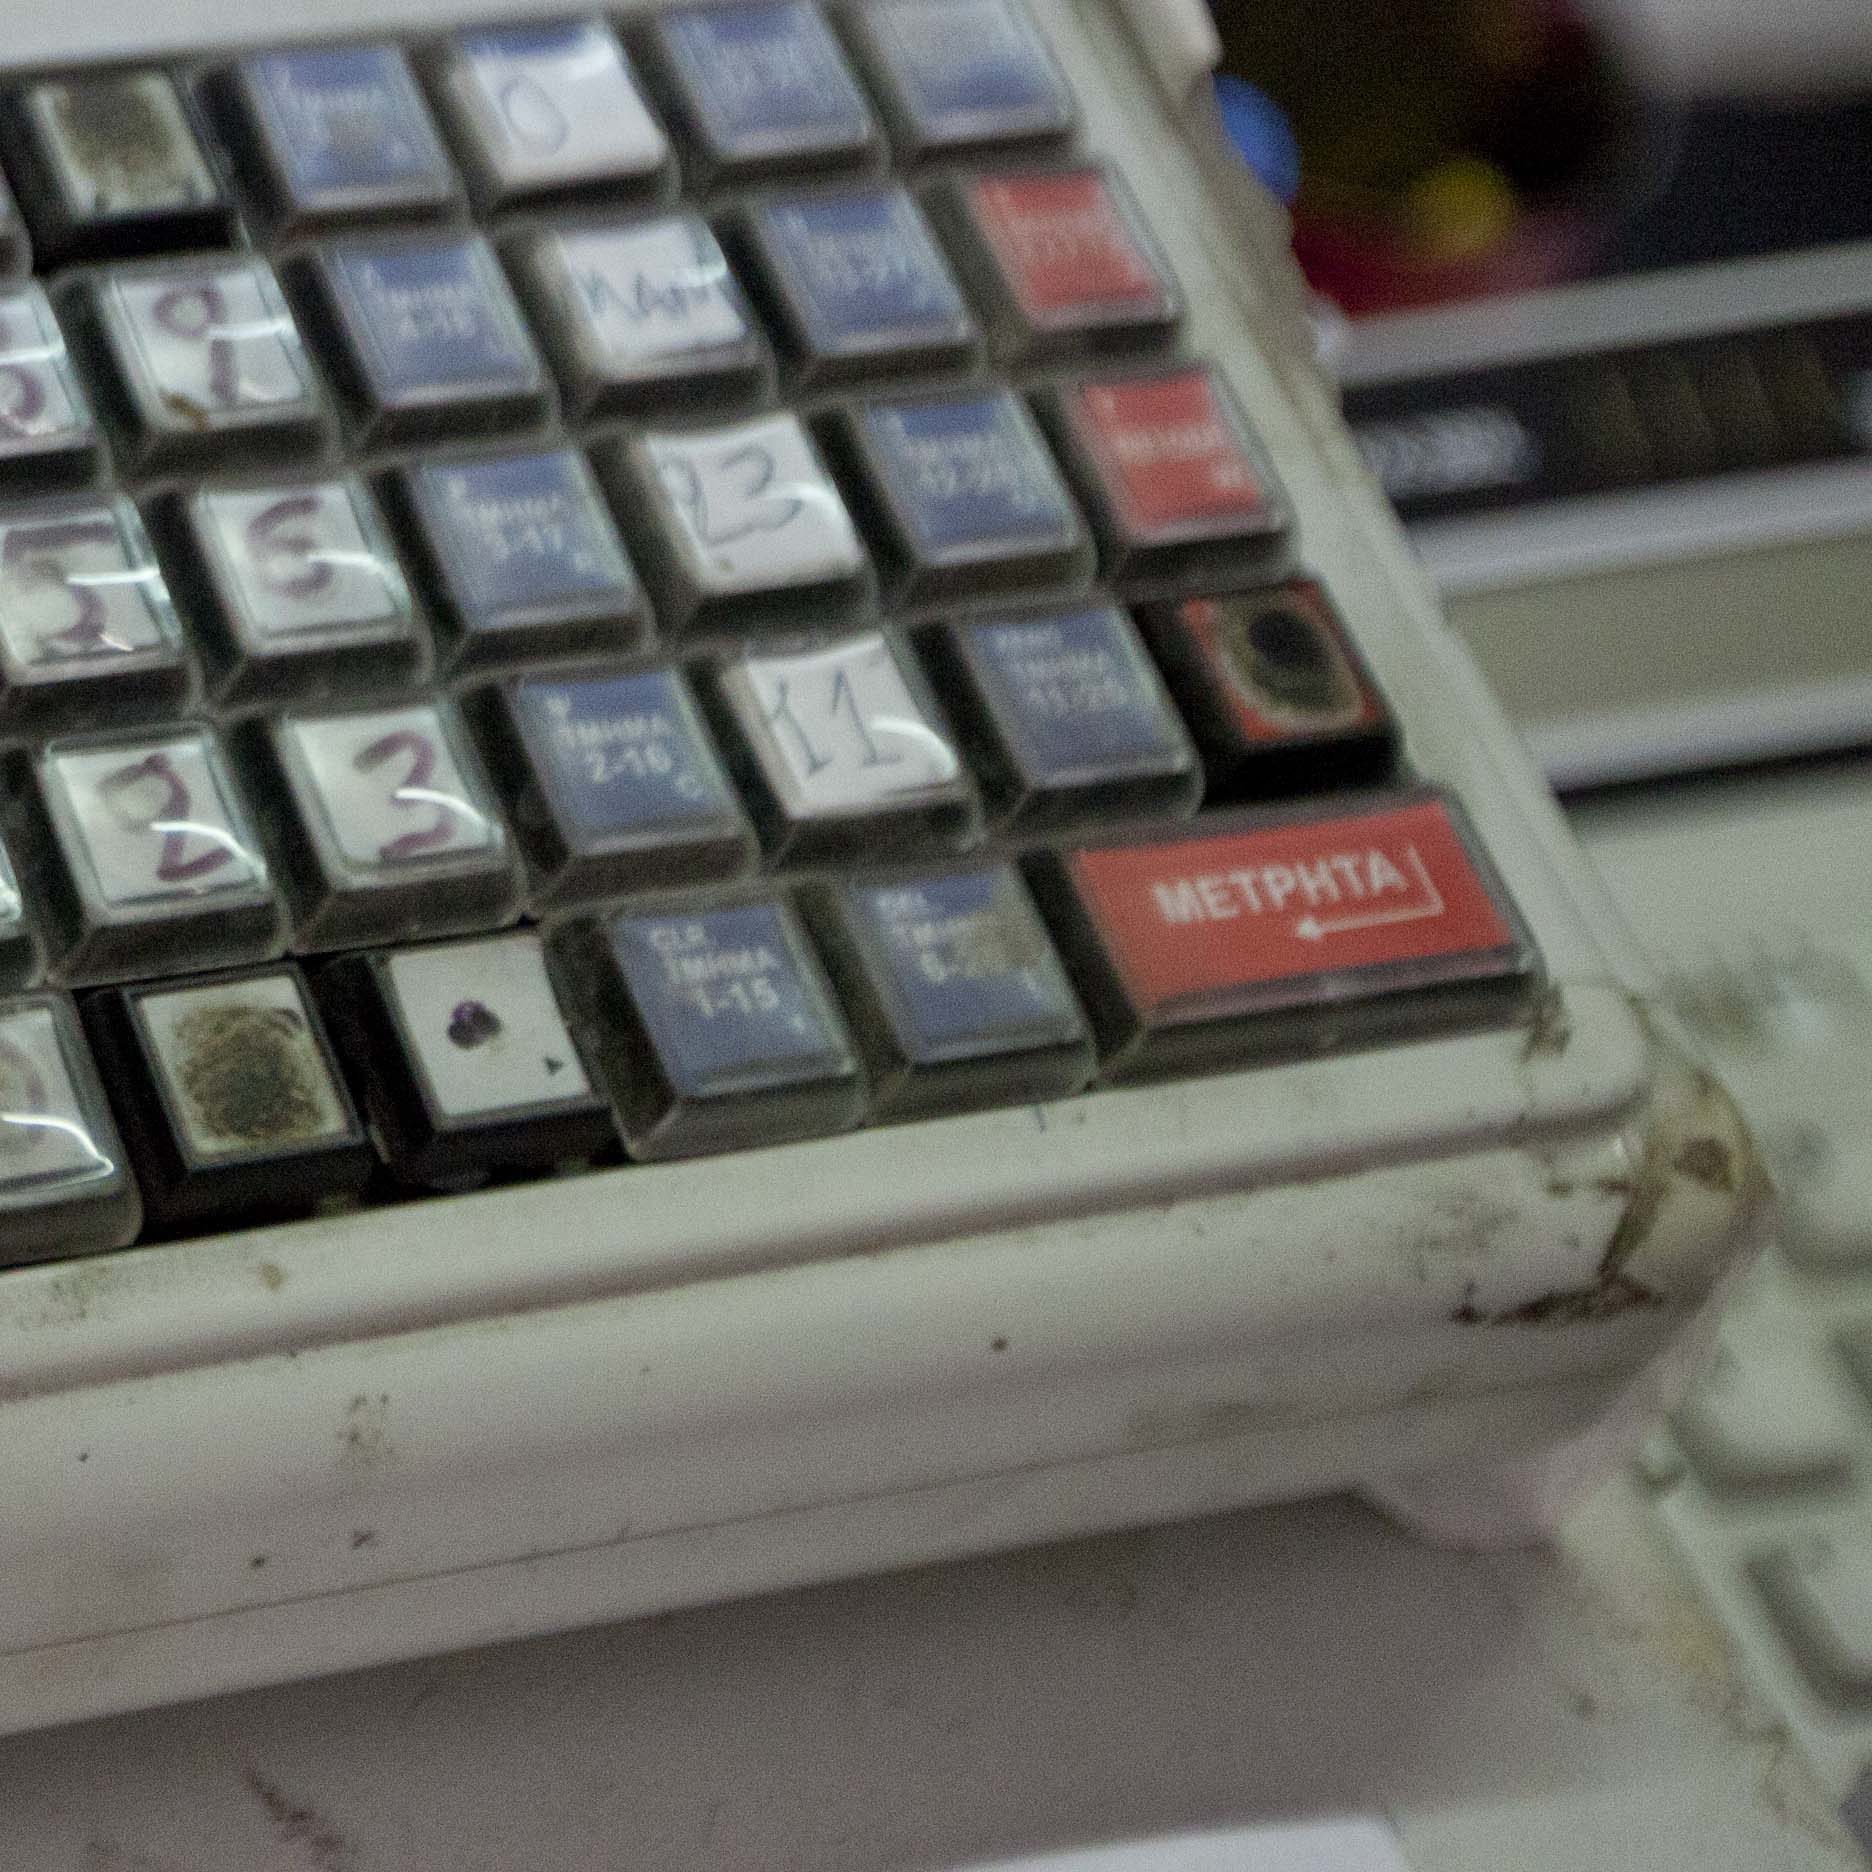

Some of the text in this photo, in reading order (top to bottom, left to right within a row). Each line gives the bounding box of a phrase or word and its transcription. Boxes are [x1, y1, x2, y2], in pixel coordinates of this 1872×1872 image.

[151, 283, 238, 407] 9
[98, 751, 235, 882] 2
[354, 729, 456, 861] 3
[1153, 847, 1407, 925] ΜΕΤΡΗΤΑ
